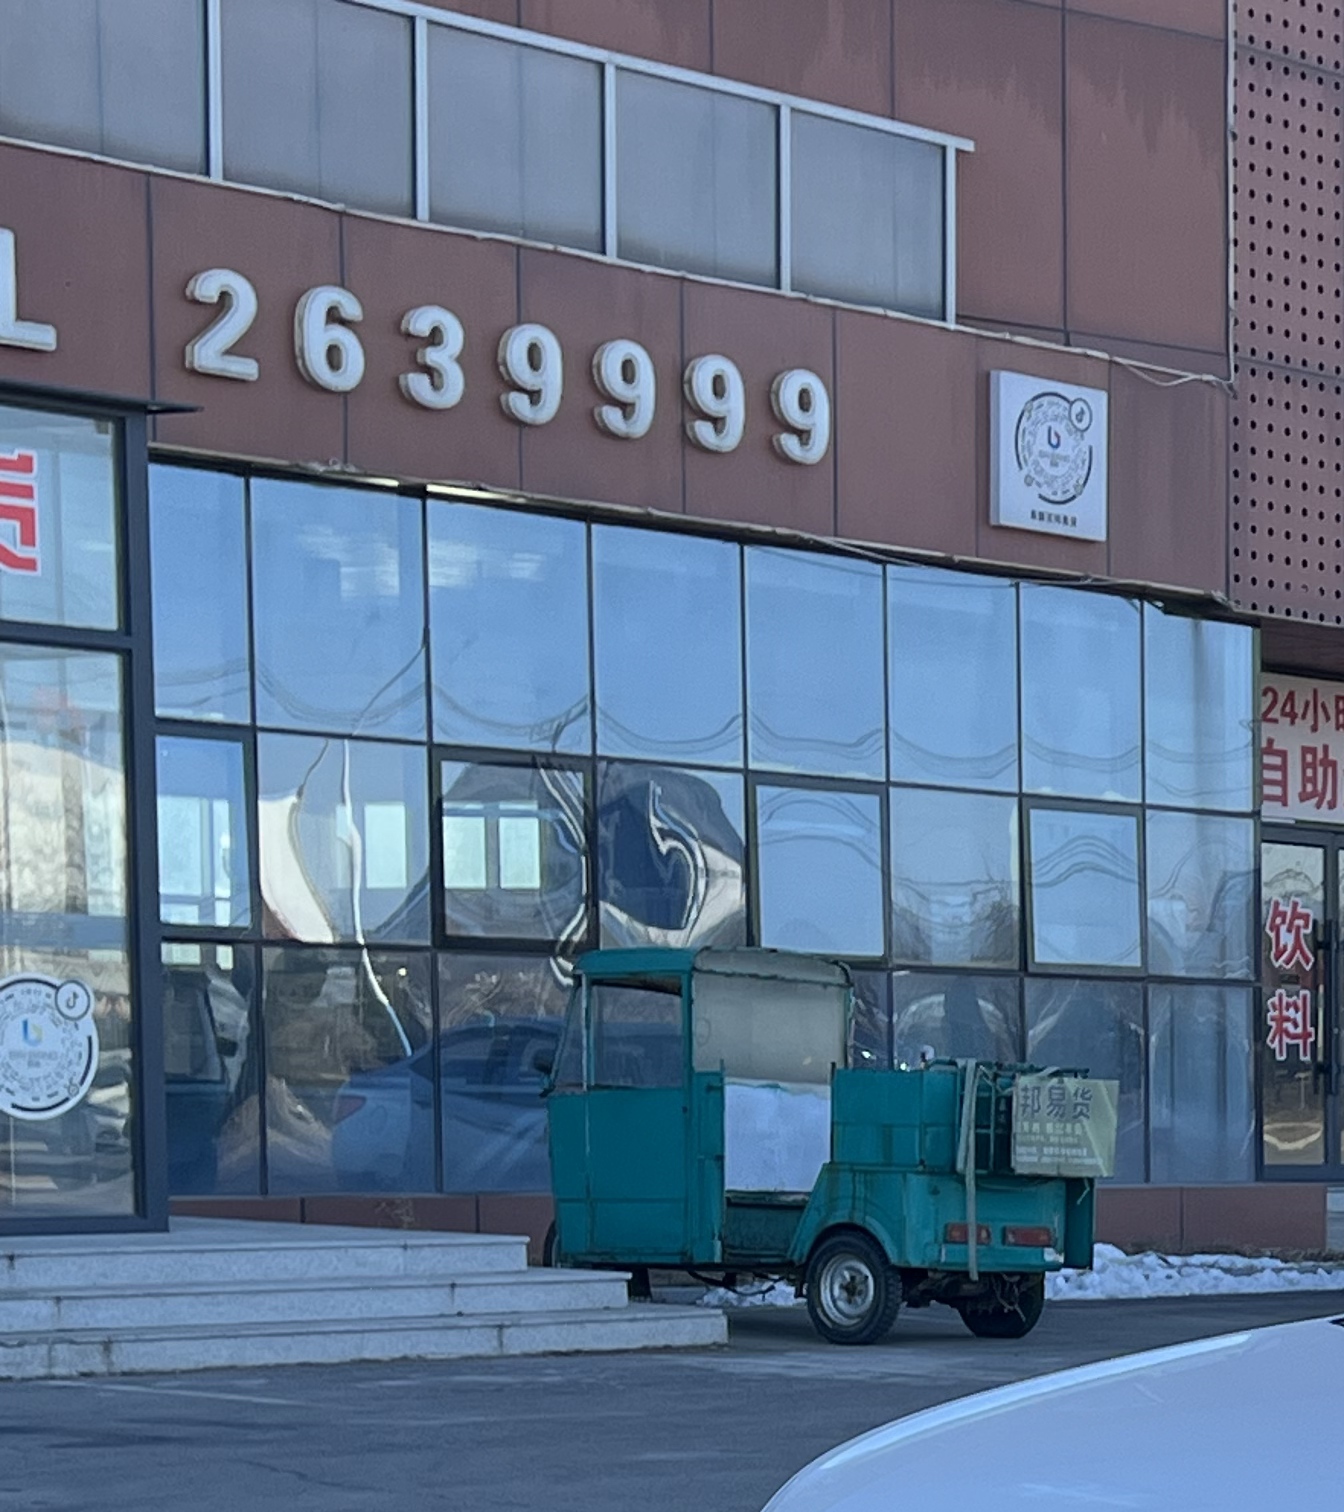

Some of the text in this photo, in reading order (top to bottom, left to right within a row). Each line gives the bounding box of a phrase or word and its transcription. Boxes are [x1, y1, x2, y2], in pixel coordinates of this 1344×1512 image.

[184, 267, 831, 466] 2639999
[1020, 1083, 1094, 1120] 邦易货
